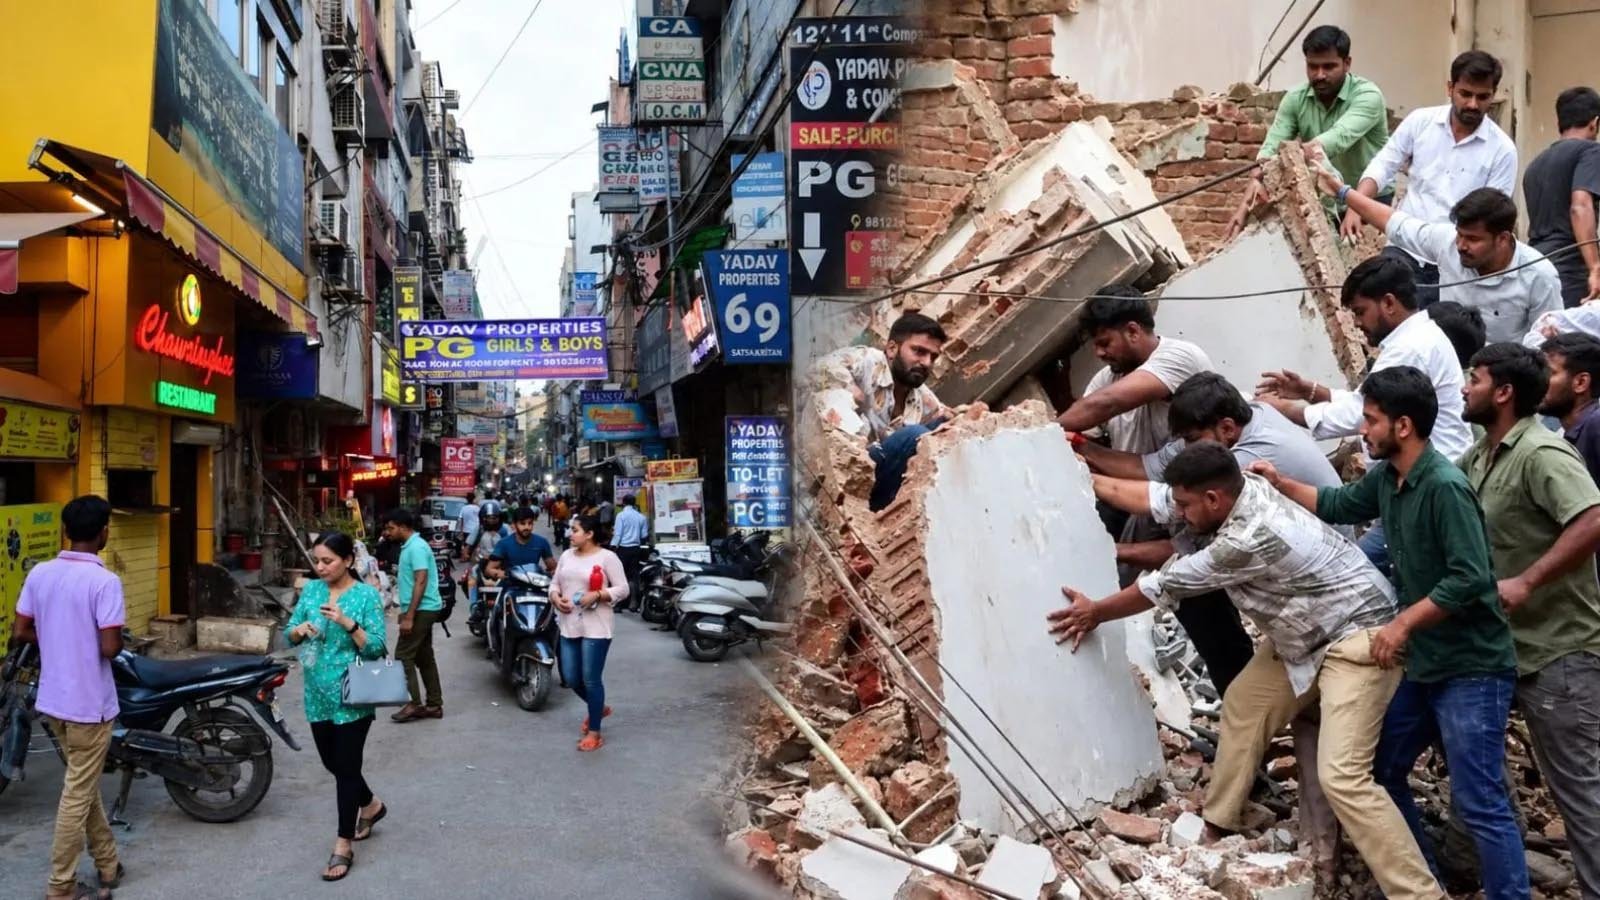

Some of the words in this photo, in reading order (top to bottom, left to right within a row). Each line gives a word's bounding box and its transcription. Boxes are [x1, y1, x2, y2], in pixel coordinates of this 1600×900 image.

[649, 20, 692, 34] CA
[642, 63, 702, 78] CWA
[836, 58, 889, 80] YADAV
[846, 88, 857, 109] &
[798, 160, 875, 198] PG
[720, 254, 778, 269] YADAV
[719, 273, 780, 286] PROPERTIES
[725, 292, 780, 344] 69
[402, 324, 476, 337] YADAV
[486, 321, 602, 335] PROPERTIES
[404, 337, 475, 359] PG
[486, 338, 535, 353] GIRLS
[540, 337, 554, 351] &
[559, 336, 604, 351] BOYS
[158, 380, 217, 415] RESTAURANT
[738, 424, 786, 437] YADAV
[445, 446, 472, 460] PG
[732, 467, 785, 482] TO-LET
